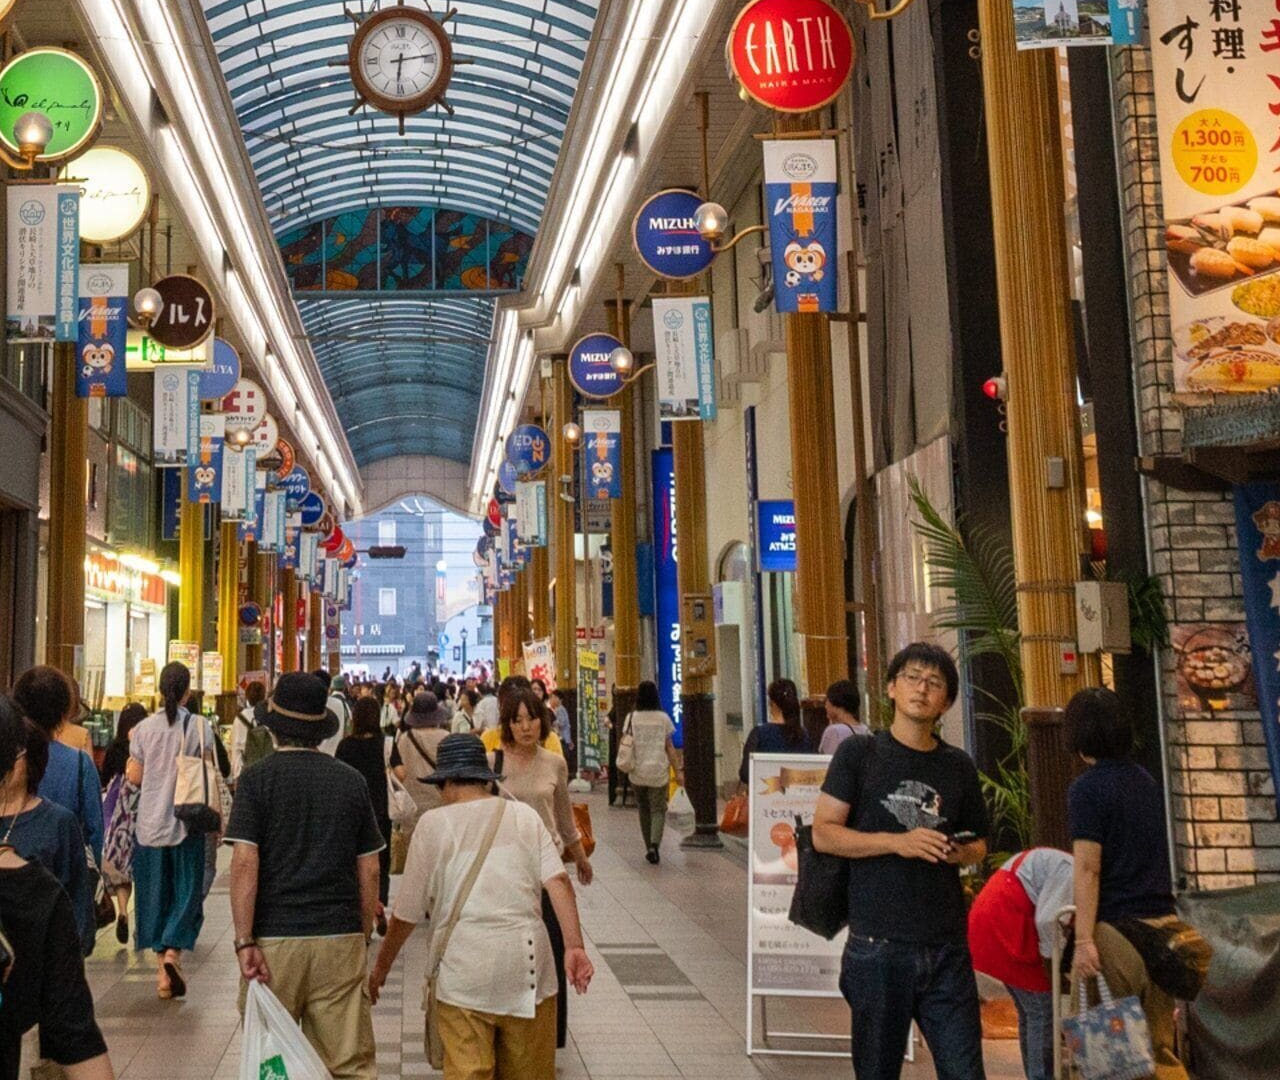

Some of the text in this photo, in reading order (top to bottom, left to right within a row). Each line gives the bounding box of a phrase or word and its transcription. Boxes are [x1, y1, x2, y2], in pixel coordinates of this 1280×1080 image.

[745, 15, 836, 76] EARTH
[1160, 14, 1206, 105] すし
[1201, 154, 1228, 164] 子ども
[649, 217, 701, 231] MIZUH
